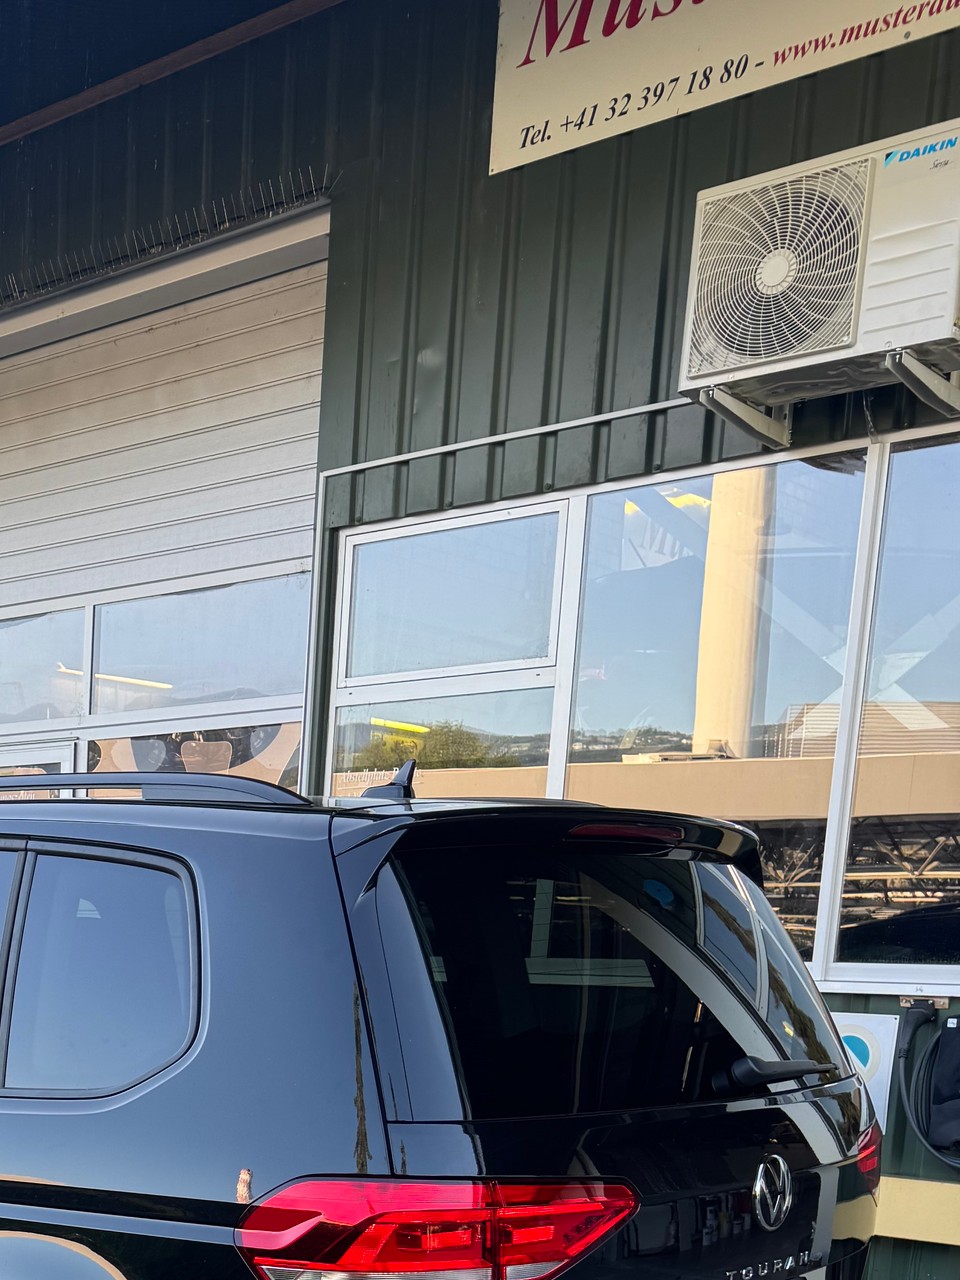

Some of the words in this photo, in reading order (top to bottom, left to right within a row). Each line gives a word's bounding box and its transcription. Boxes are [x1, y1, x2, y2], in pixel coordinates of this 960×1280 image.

[518, 120, 552, 150] Tel.
[559, 103, 599, 134] +41
[604, 92, 633, 122] 32
[637, 76, 681, 111] 397
[684, 65, 712, 97] 18
[719, 53, 750, 86] 80
[898, 136, 959, 163] DAIKIN
